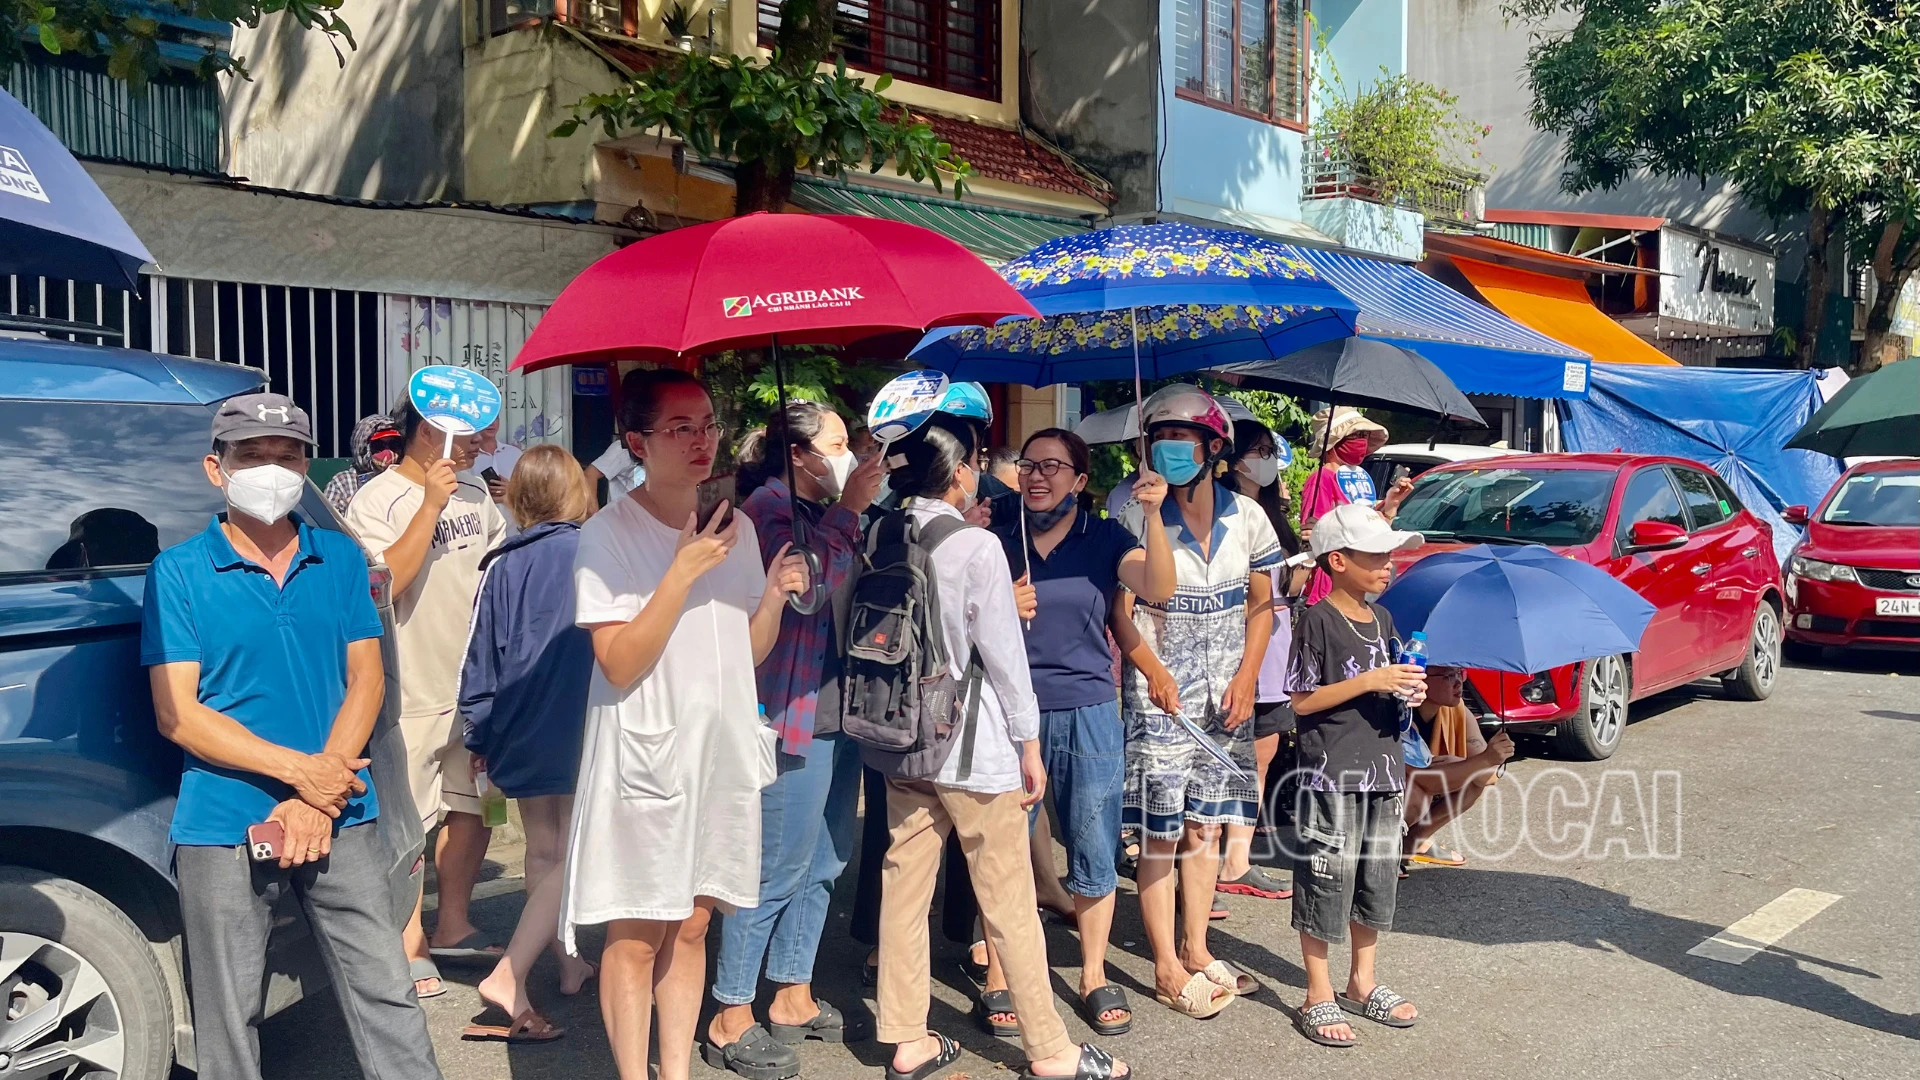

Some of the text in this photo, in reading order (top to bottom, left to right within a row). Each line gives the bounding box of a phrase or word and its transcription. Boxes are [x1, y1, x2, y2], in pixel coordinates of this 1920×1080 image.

[752, 287, 865, 308] AGRIBANK
[784, 303, 811, 312] NHÁNH
[1311, 855, 1328, 873] 1977
